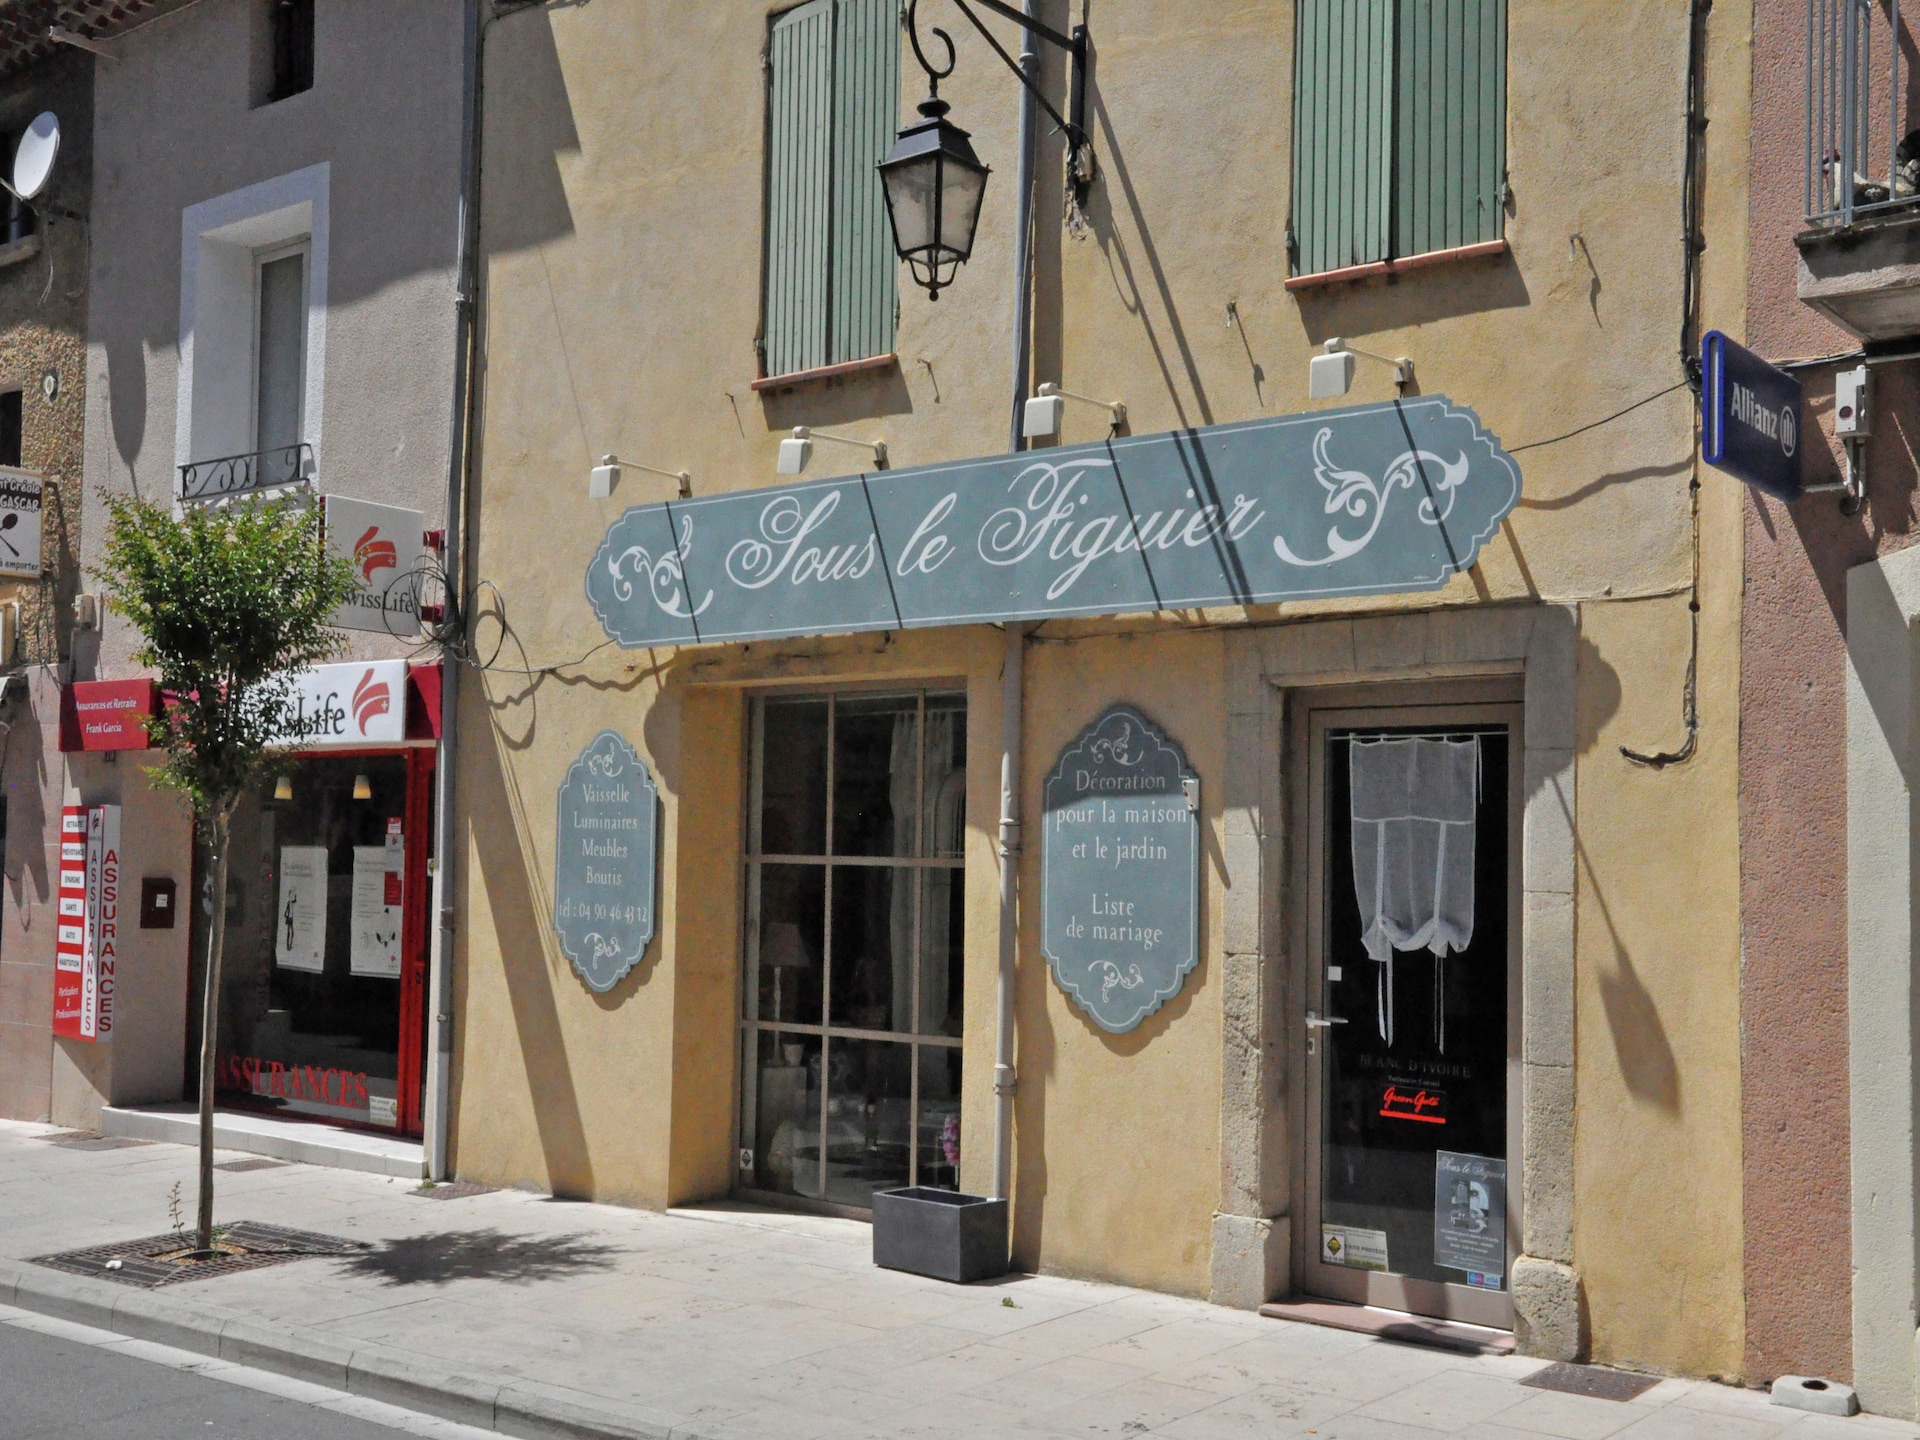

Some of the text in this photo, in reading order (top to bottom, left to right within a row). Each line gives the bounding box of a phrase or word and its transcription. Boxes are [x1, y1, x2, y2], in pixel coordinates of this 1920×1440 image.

[1731, 381, 1778, 441] Allianz
[9, 478, 41, 495] Créole
[725, 457, 1266, 600] Sous le Figuier
[5, 561, 39, 571] emporter
[75, 697, 137, 712] Assurances et Retraite
[86, 721, 122, 734] Frank Garcia
[1075, 769, 1166, 791] Décoration
[582, 784, 630, 803] Vaisselle
[573, 811, 638, 830] Luminaires
[1056, 800, 1187, 831] pour la maison
[582, 838, 628, 858] Meubles
[1072, 836, 1168, 869] et le jardin
[586, 866, 622, 886] Boutis
[578, 902, 591, 921] 04
[594, 903, 607, 922] 90
[609, 903, 621, 923] 46
[637, 906, 647, 922] 12
[1092, 893, 1135, 916] Liste
[65, 931, 76, 940] AUTO
[85, 848, 98, 1032] ASSURANCES
[98, 849, 118, 1032] ASSURANCES
[1066, 916, 1163, 950] de mariage
[59, 956, 80, 968] HABITATION
[216, 1054, 368, 1110] ASSURANCES
